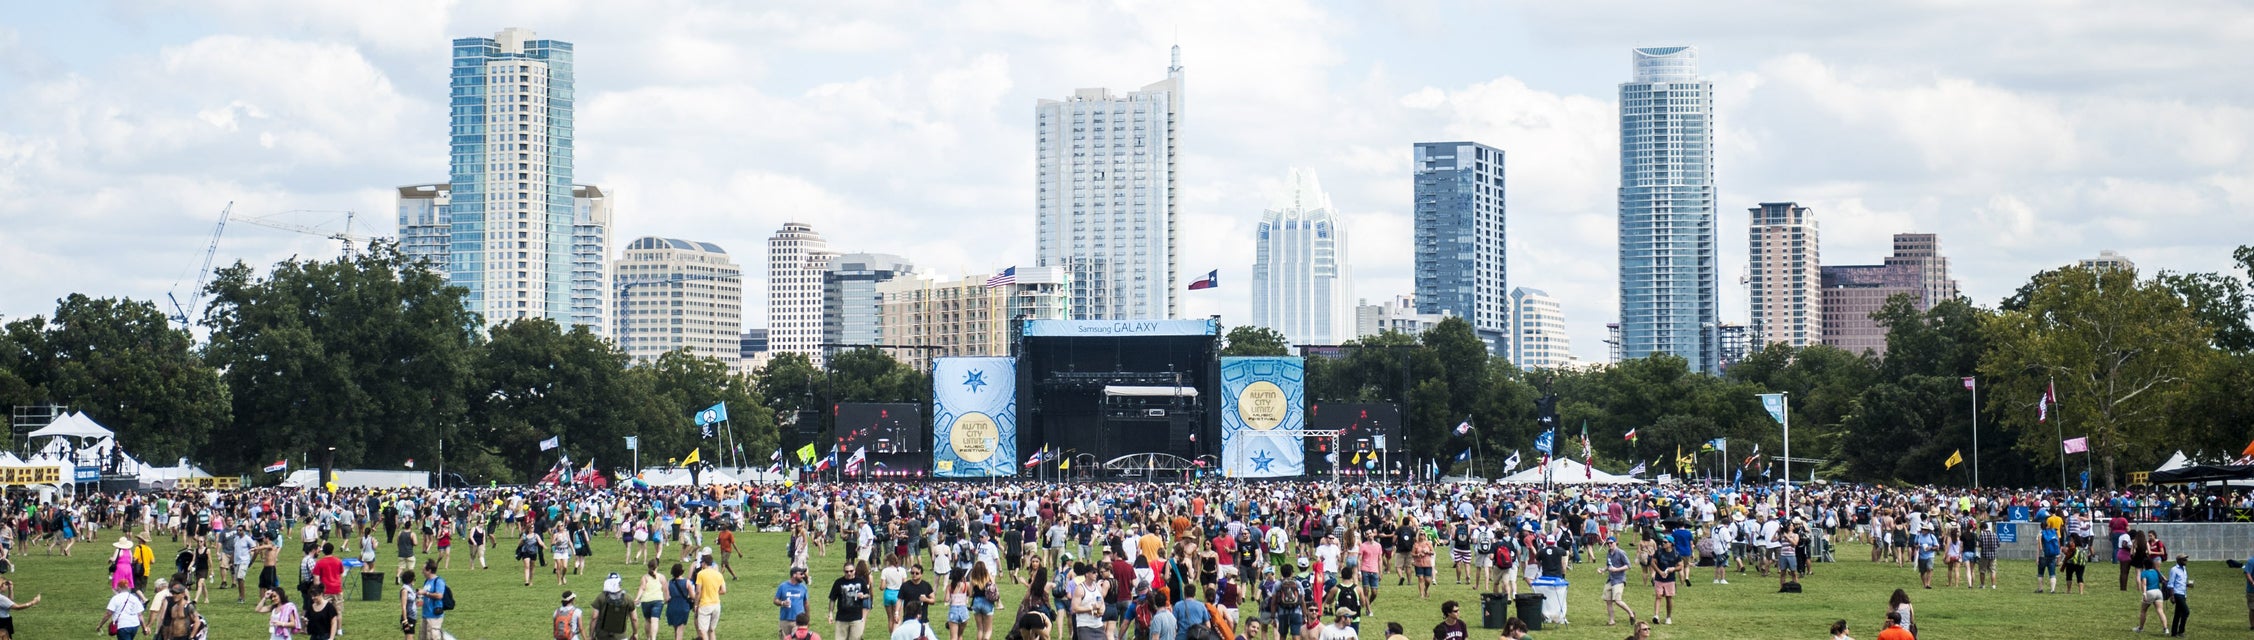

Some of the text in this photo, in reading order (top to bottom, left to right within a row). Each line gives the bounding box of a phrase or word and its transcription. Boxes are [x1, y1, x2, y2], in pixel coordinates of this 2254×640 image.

[1078, 322, 1158, 334] Samsung GALAXY
[199, 478, 214, 488] BAR
